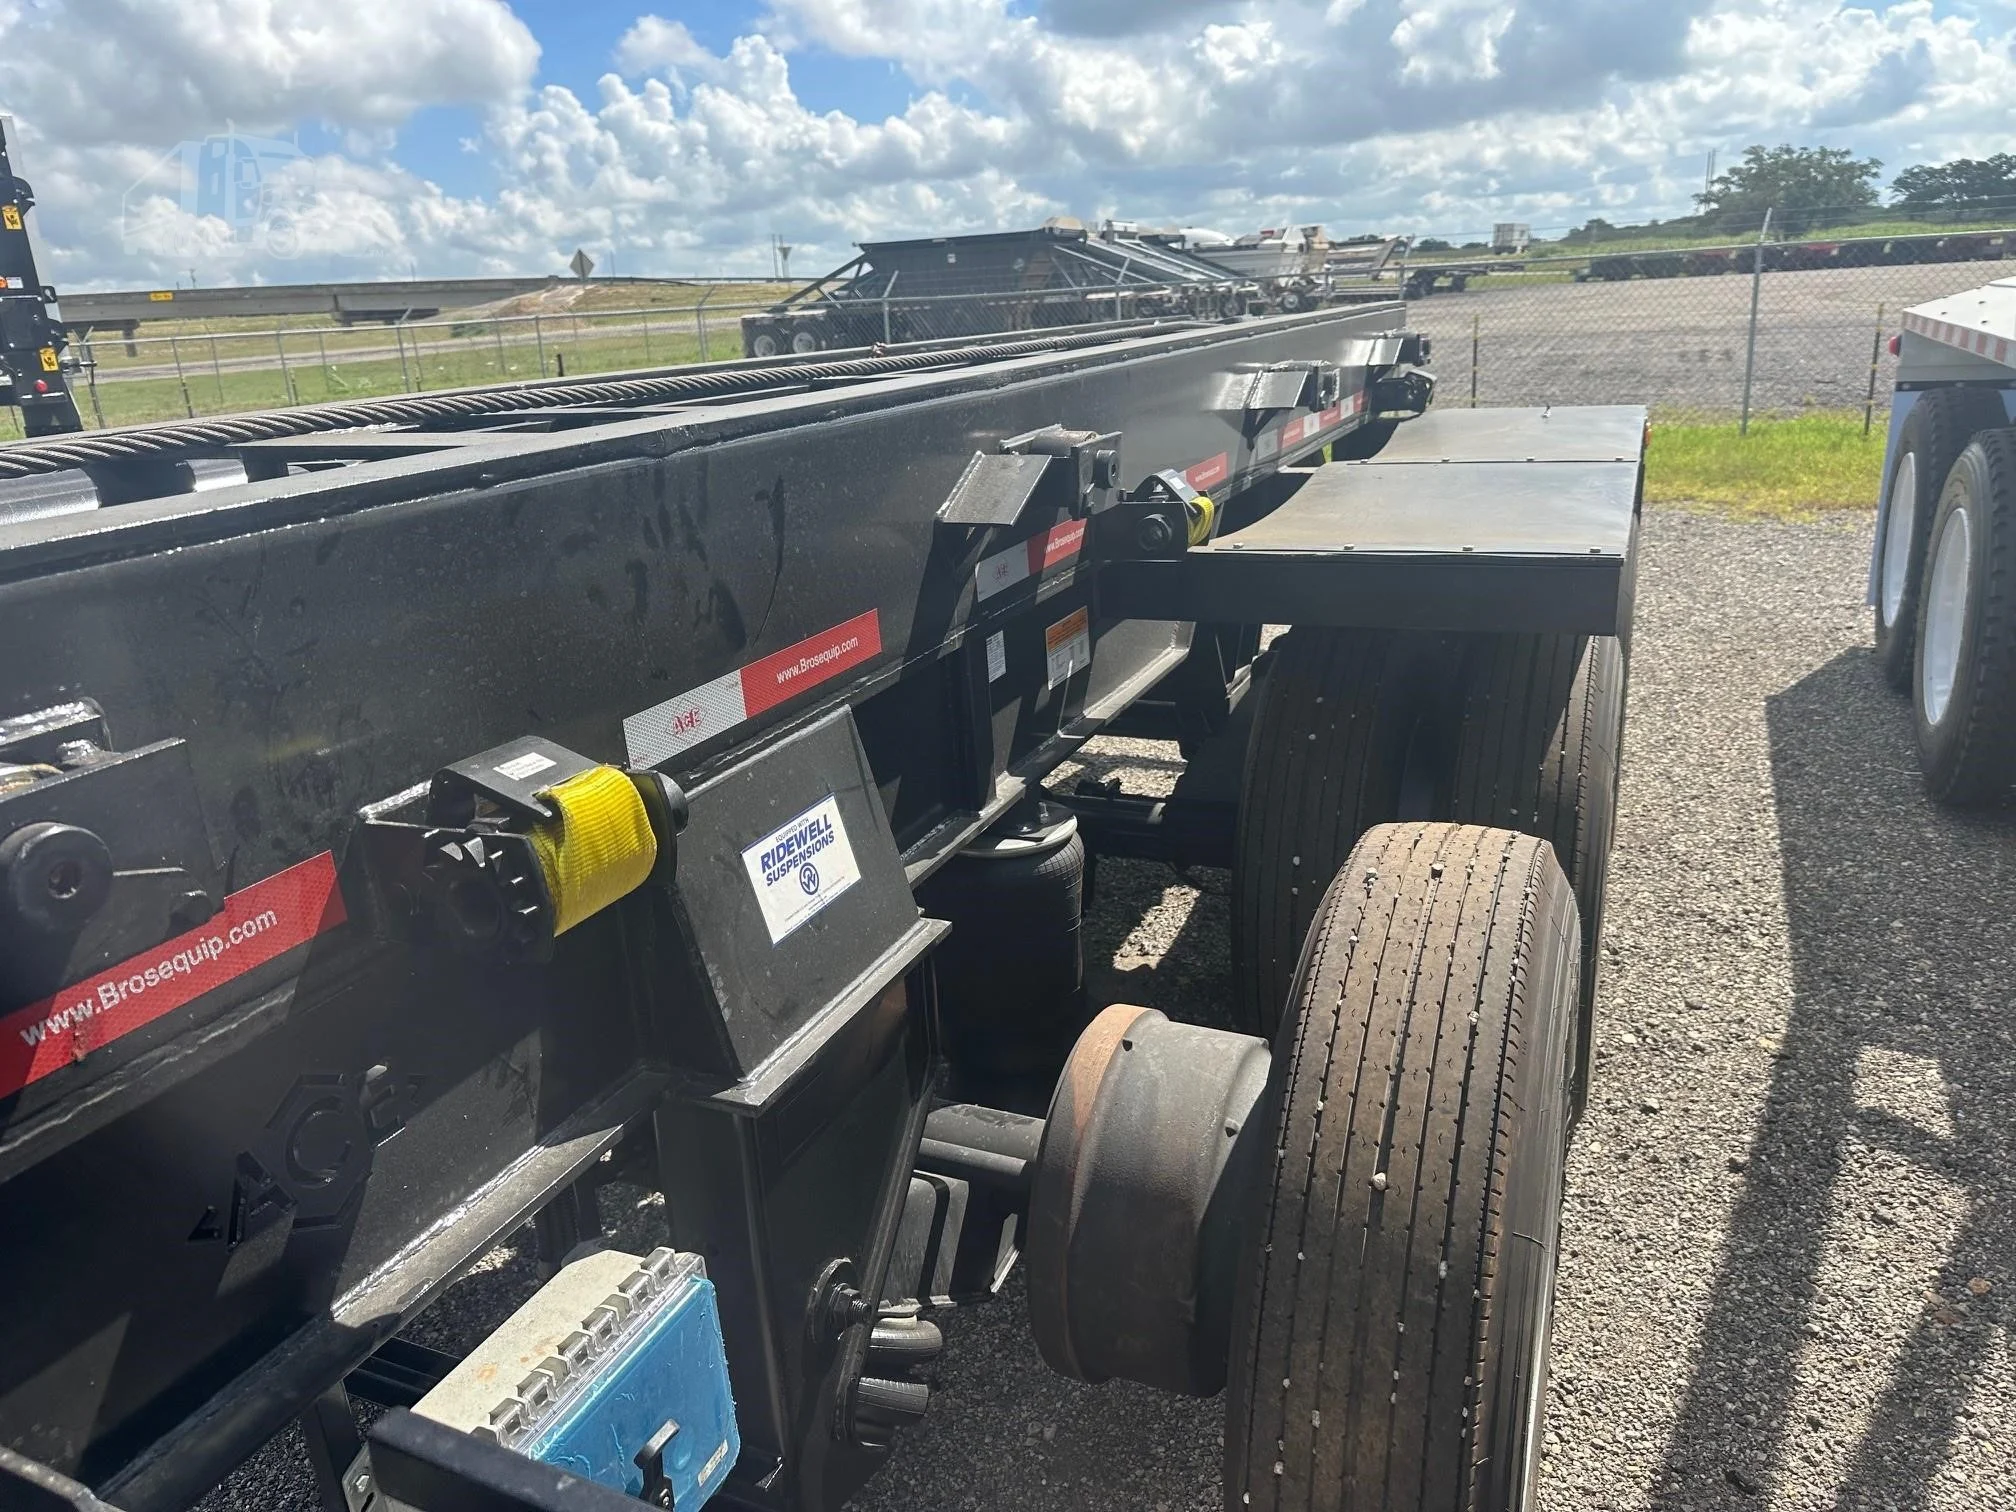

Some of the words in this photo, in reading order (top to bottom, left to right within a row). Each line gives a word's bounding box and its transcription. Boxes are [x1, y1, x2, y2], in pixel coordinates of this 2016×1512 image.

[776, 635, 858, 685] www.Brosequip.com
[760, 813, 832, 874] RIDEWELL
[775, 825, 798, 843] EQUIPPED
[797, 816, 810, 830] WITH
[765, 830, 835, 887] SUSPENSIONS
[20, 910, 278, 1046] www.Brosequip.com
